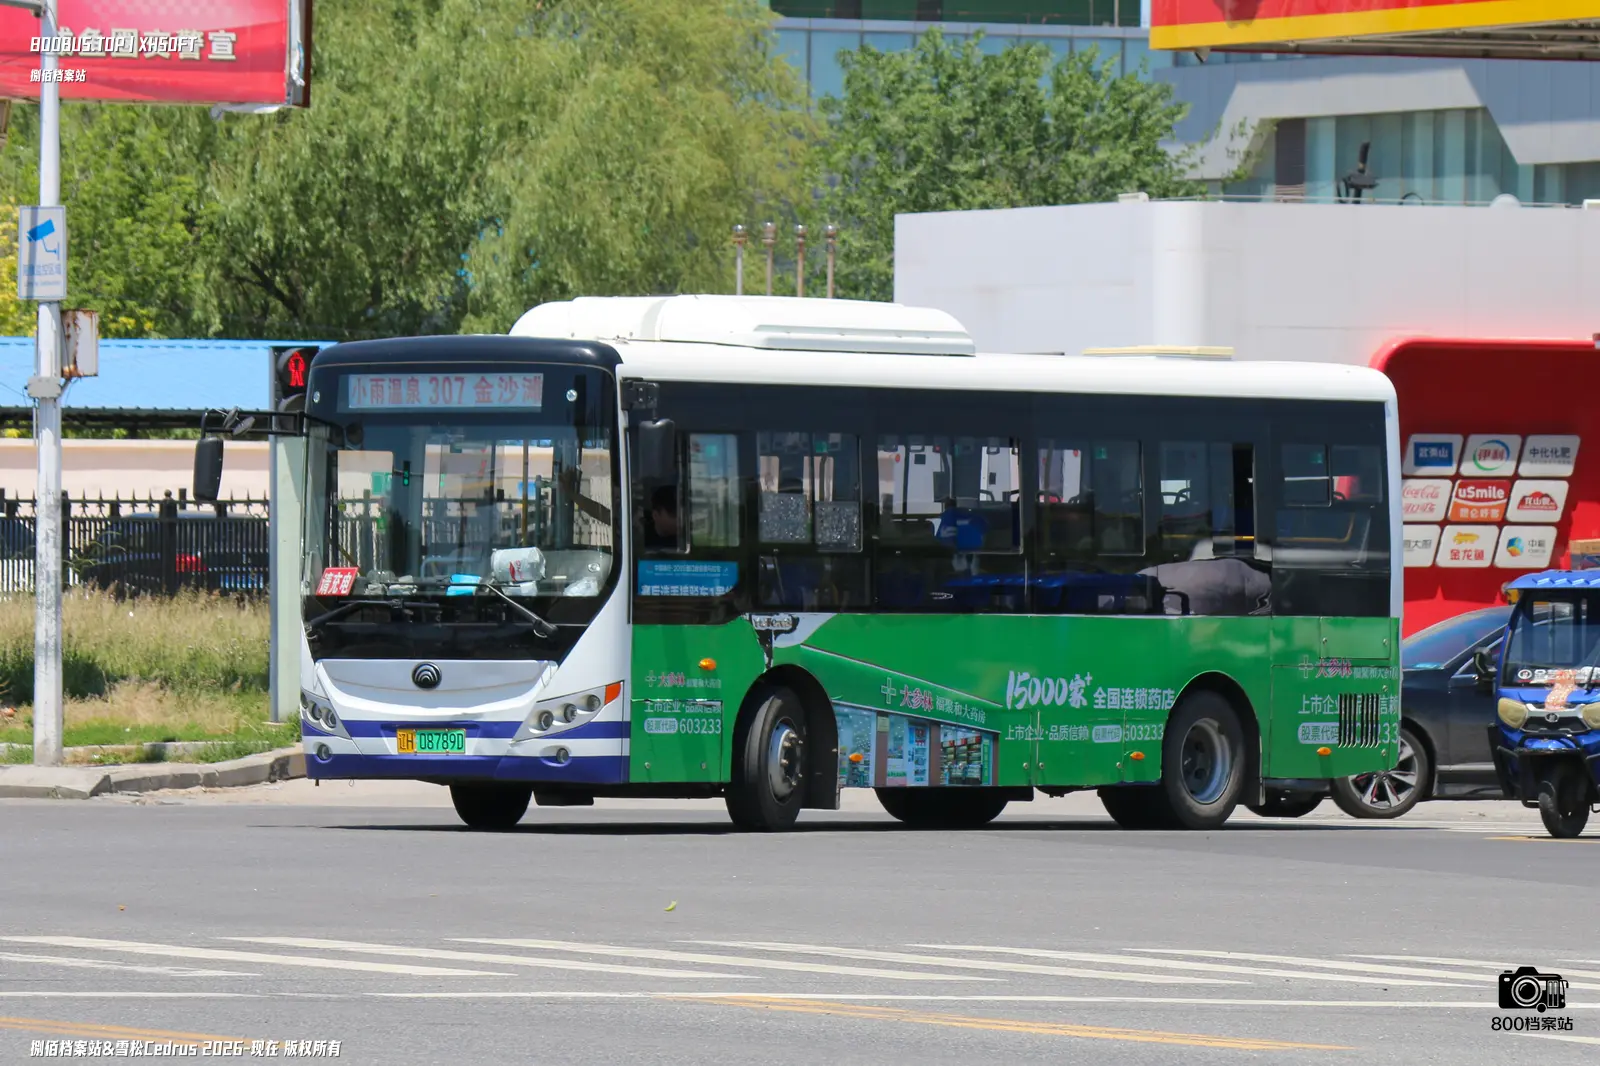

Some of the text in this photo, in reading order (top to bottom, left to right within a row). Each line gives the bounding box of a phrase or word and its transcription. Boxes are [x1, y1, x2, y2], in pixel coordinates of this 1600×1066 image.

[429, 376, 466, 405] 307
[1458, 486, 1505, 499] uSmile
[1450, 549, 1485, 560] 金龙鱼
[900, 684, 933, 712] 大参林
[1093, 687, 1176, 710] 全国连锁药店
[680, 718, 721, 734] 603233
